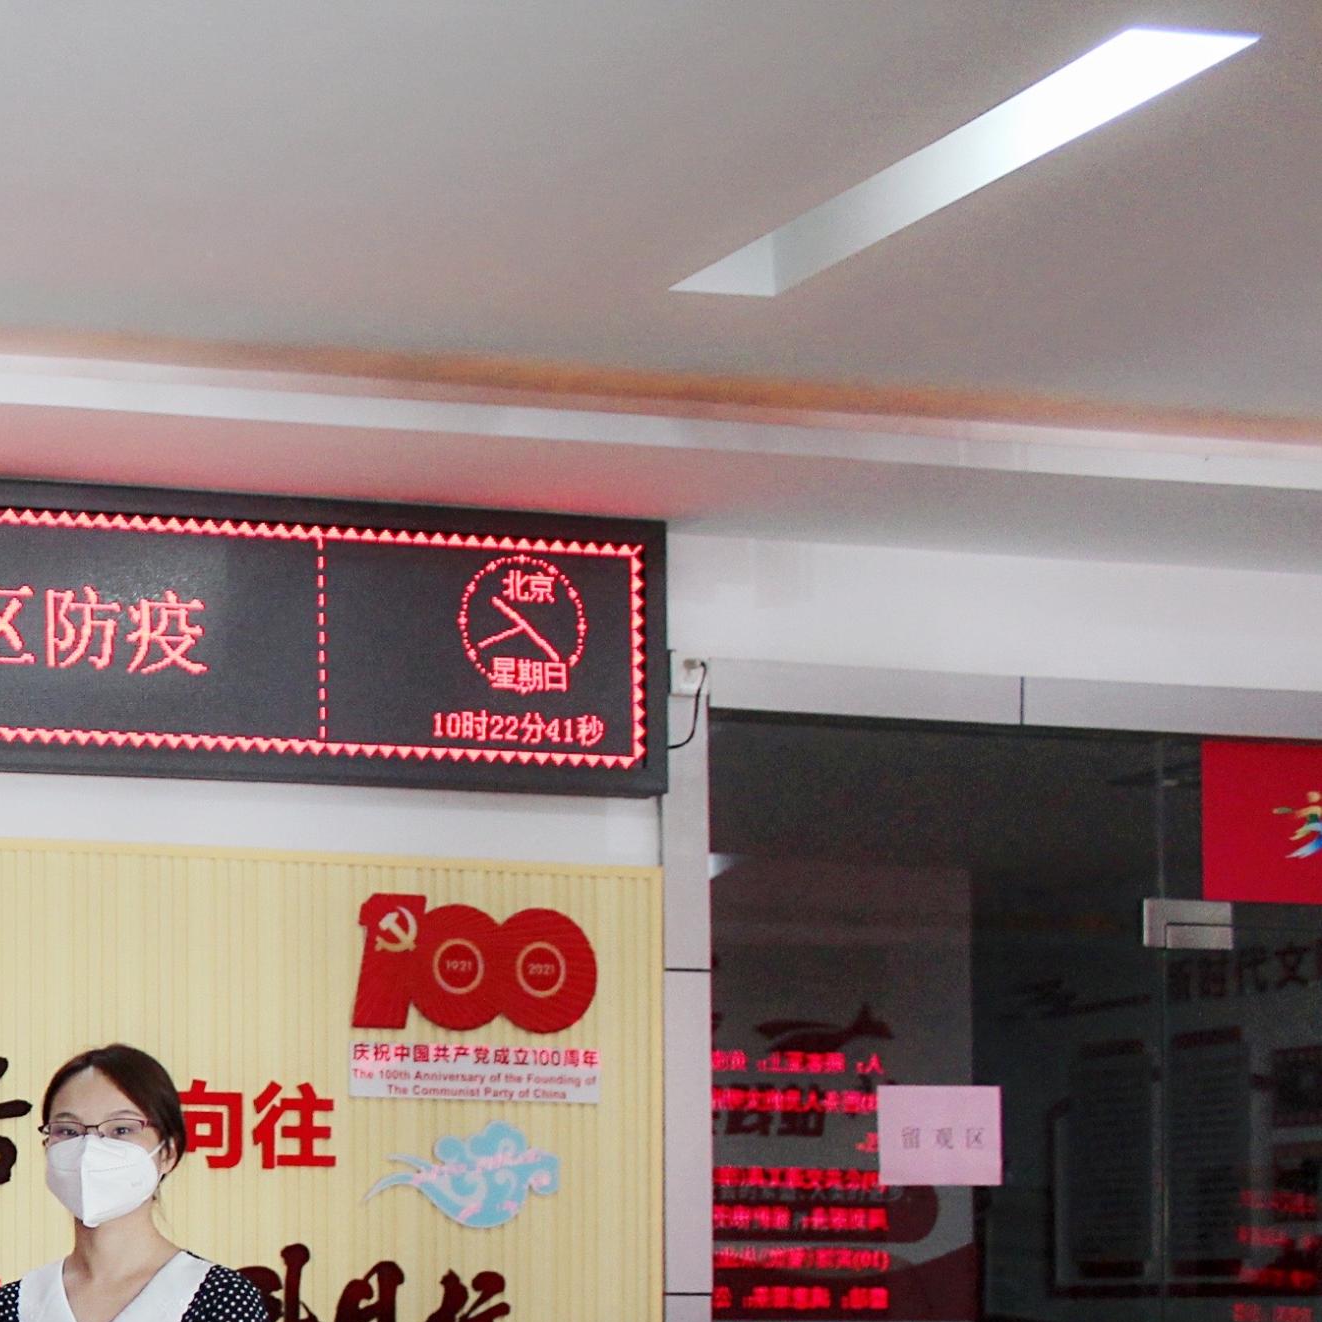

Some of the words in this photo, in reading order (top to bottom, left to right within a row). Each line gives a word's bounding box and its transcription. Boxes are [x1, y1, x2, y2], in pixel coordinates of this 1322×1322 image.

[502, 570, 555, 603] 北京
[491, 657, 569, 693] 星期日
[432, 710, 604, 746] 10时22分41秒
[445, 959, 472, 972] 1921
[527, 962, 555, 976] 2021
[353, 1043, 598, 1067] 庆祝中国共产党成立100周年
[353, 1069, 374, 1080] The
[379, 1069, 410, 1081] 100th
[414, 1070, 484, 1085] Anniversary
[490, 1072, 501, 1084] of
[506, 1073, 522, 1084] the
[527, 1074, 581, 1088] Founding
[586, 1075, 596, 1086] of
[388, 1084, 409, 1095] The
[413, 1085, 480, 1097] Communist
[484, 1086, 514, 1100] Party
[519, 1087, 530, 1098] of
[534, 1088, 567, 1100] China
[901, 1127, 985, 1150] 留观区
